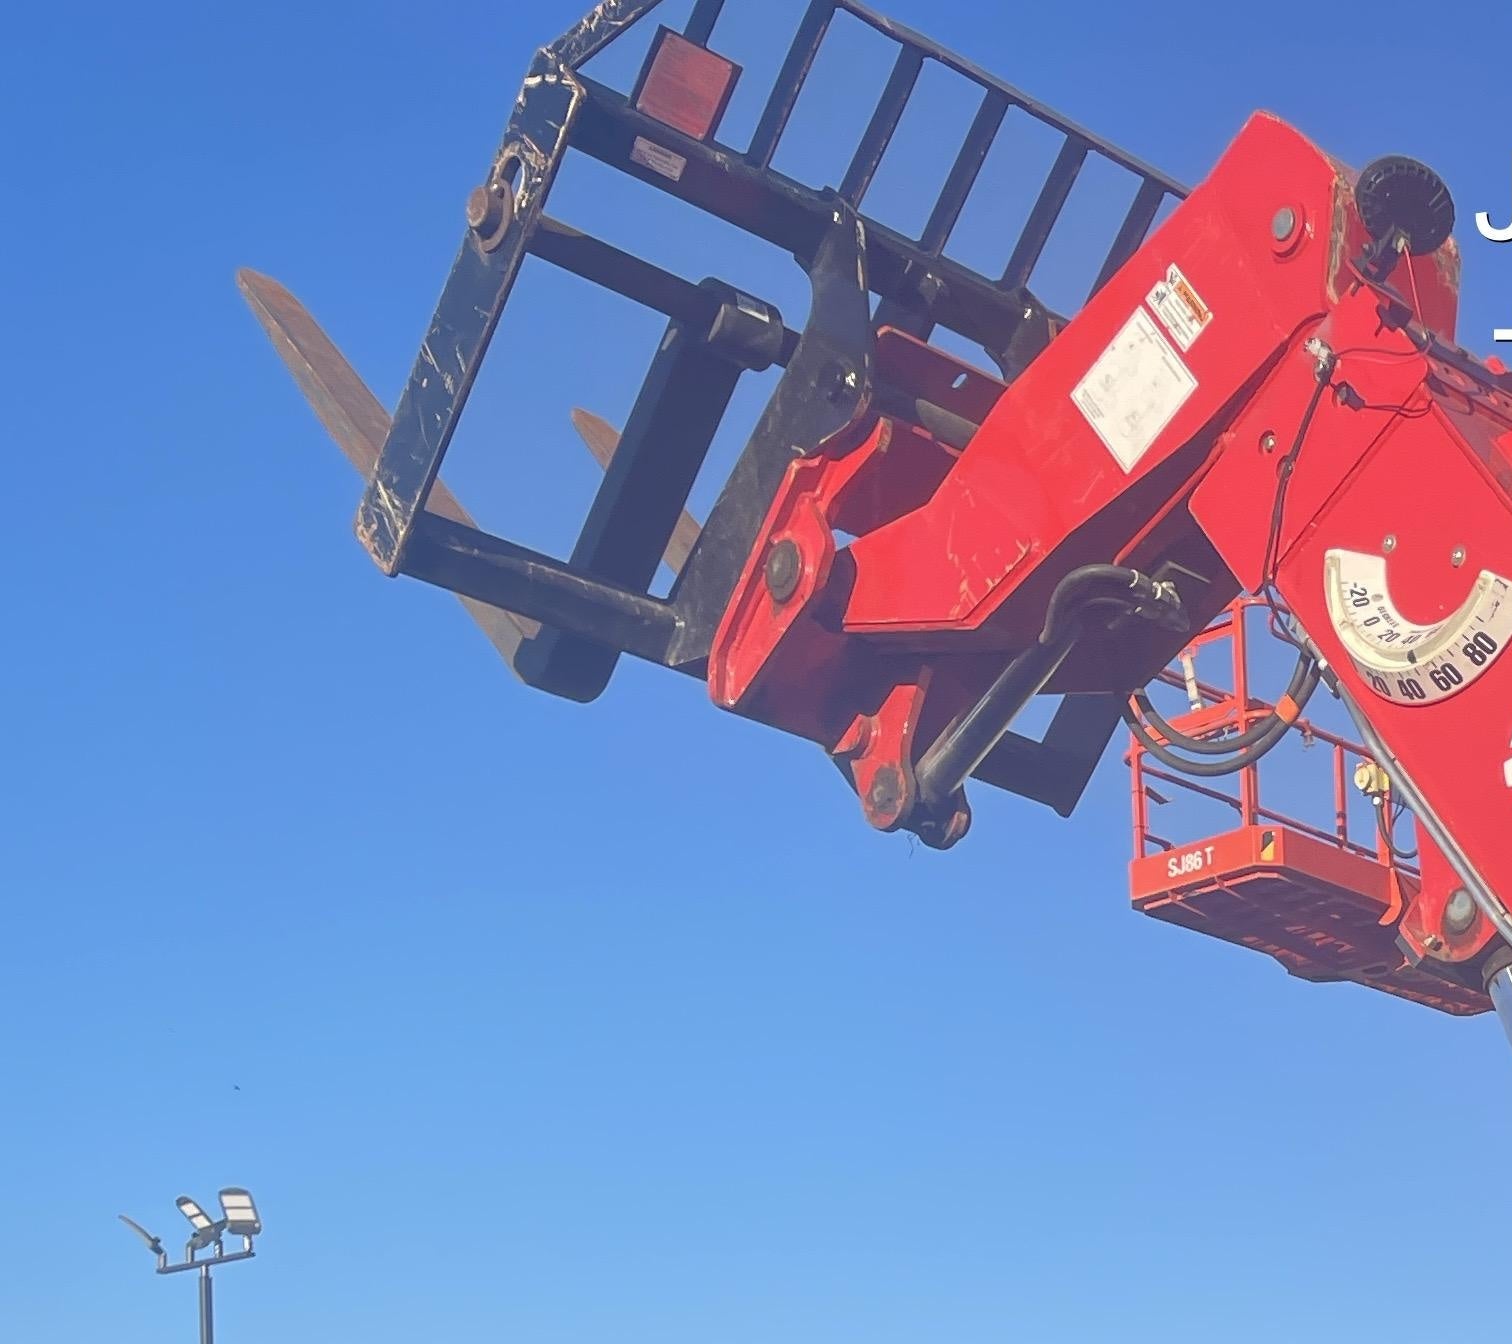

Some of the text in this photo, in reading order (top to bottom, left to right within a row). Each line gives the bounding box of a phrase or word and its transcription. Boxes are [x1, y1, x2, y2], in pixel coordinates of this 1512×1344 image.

[1396, 678, 1427, 700] 40
[1428, 662, 1464, 692] 60
[1462, 631, 1498, 667] 80
[1167, 846, 1214, 878] SJ86 T
